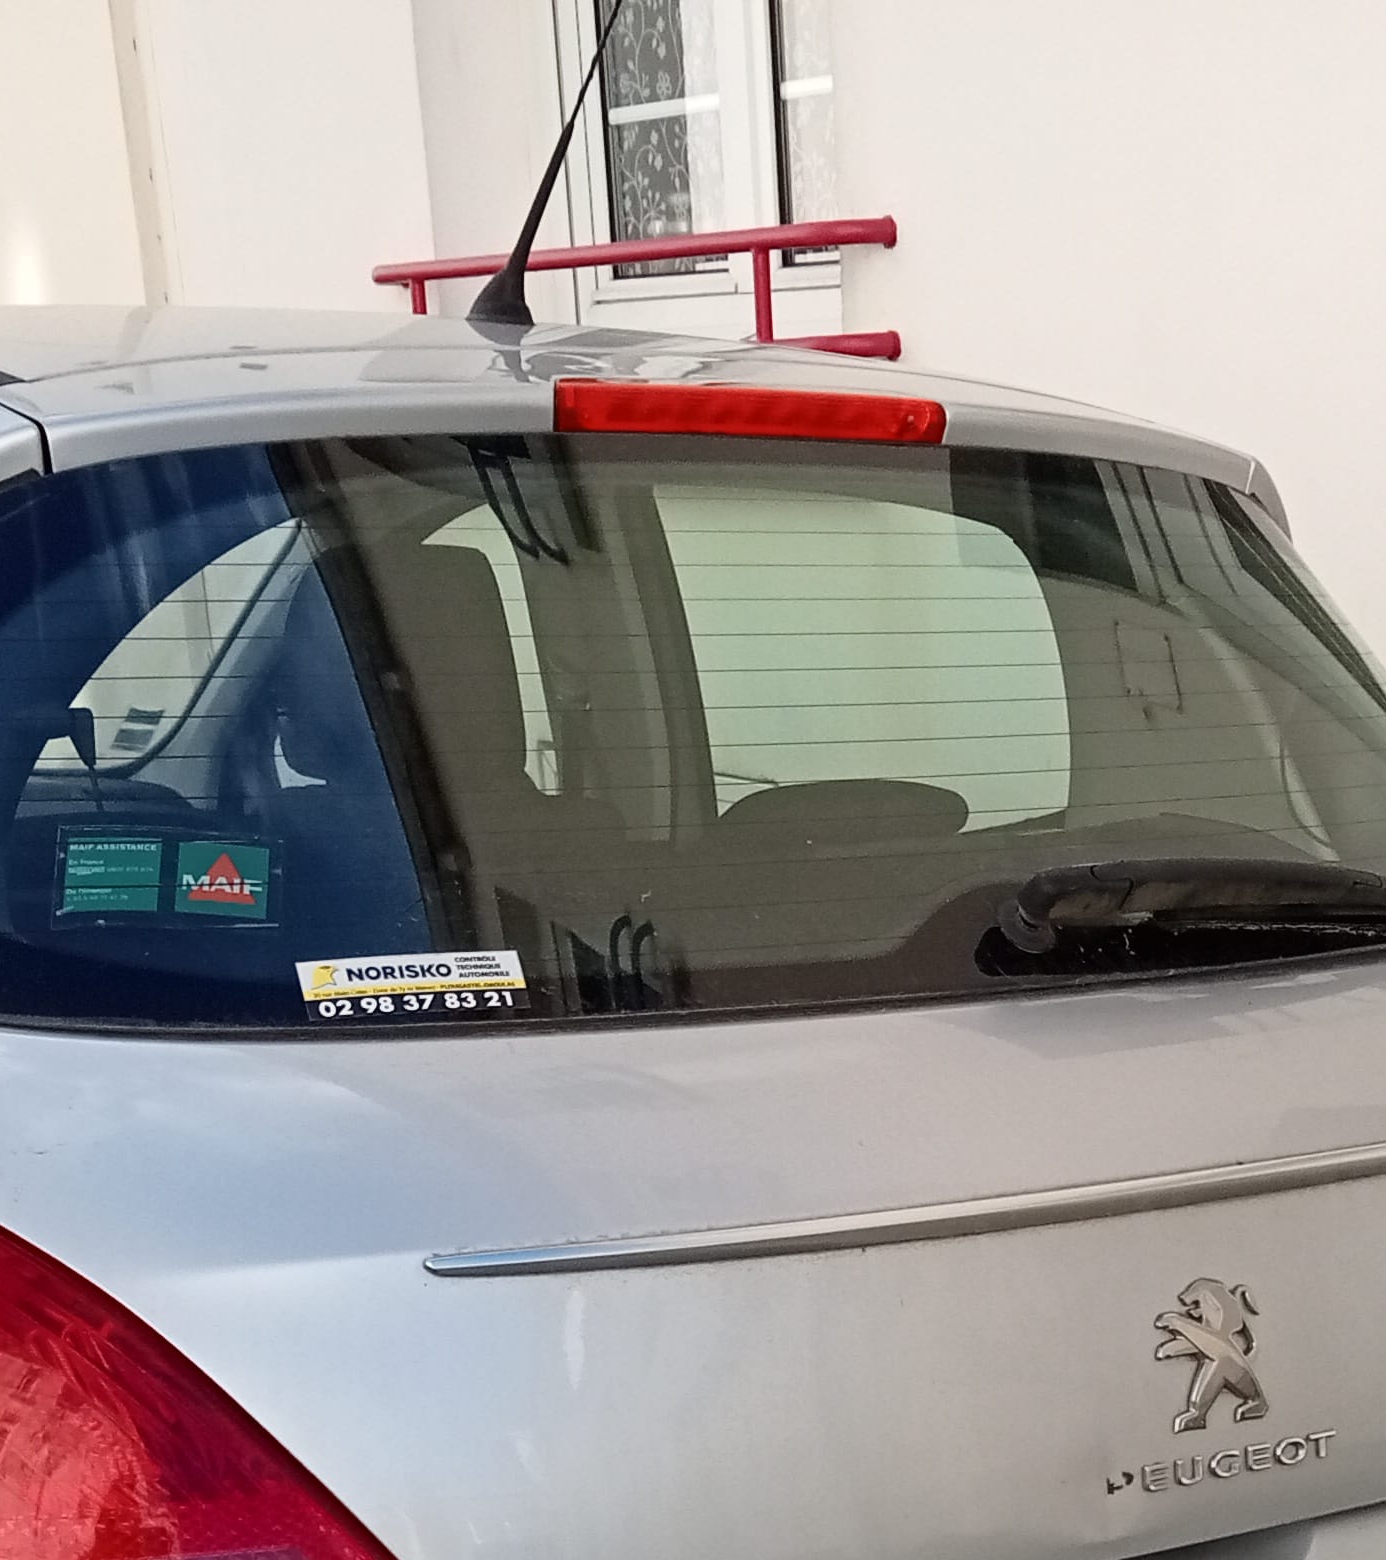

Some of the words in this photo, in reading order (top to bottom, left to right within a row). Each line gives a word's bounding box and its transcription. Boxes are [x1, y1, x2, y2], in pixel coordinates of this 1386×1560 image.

[96, 843, 157, 851] ASSISTANCE
[181, 874, 262, 895] MAIF
[345, 963, 452, 982] NORISKO
[318, 999, 354, 1018] 02
[360, 997, 395, 1014] 98
[403, 994, 434, 1011] 37
[444, 992, 477, 1009] 83
[483, 991, 514, 1008] 21
